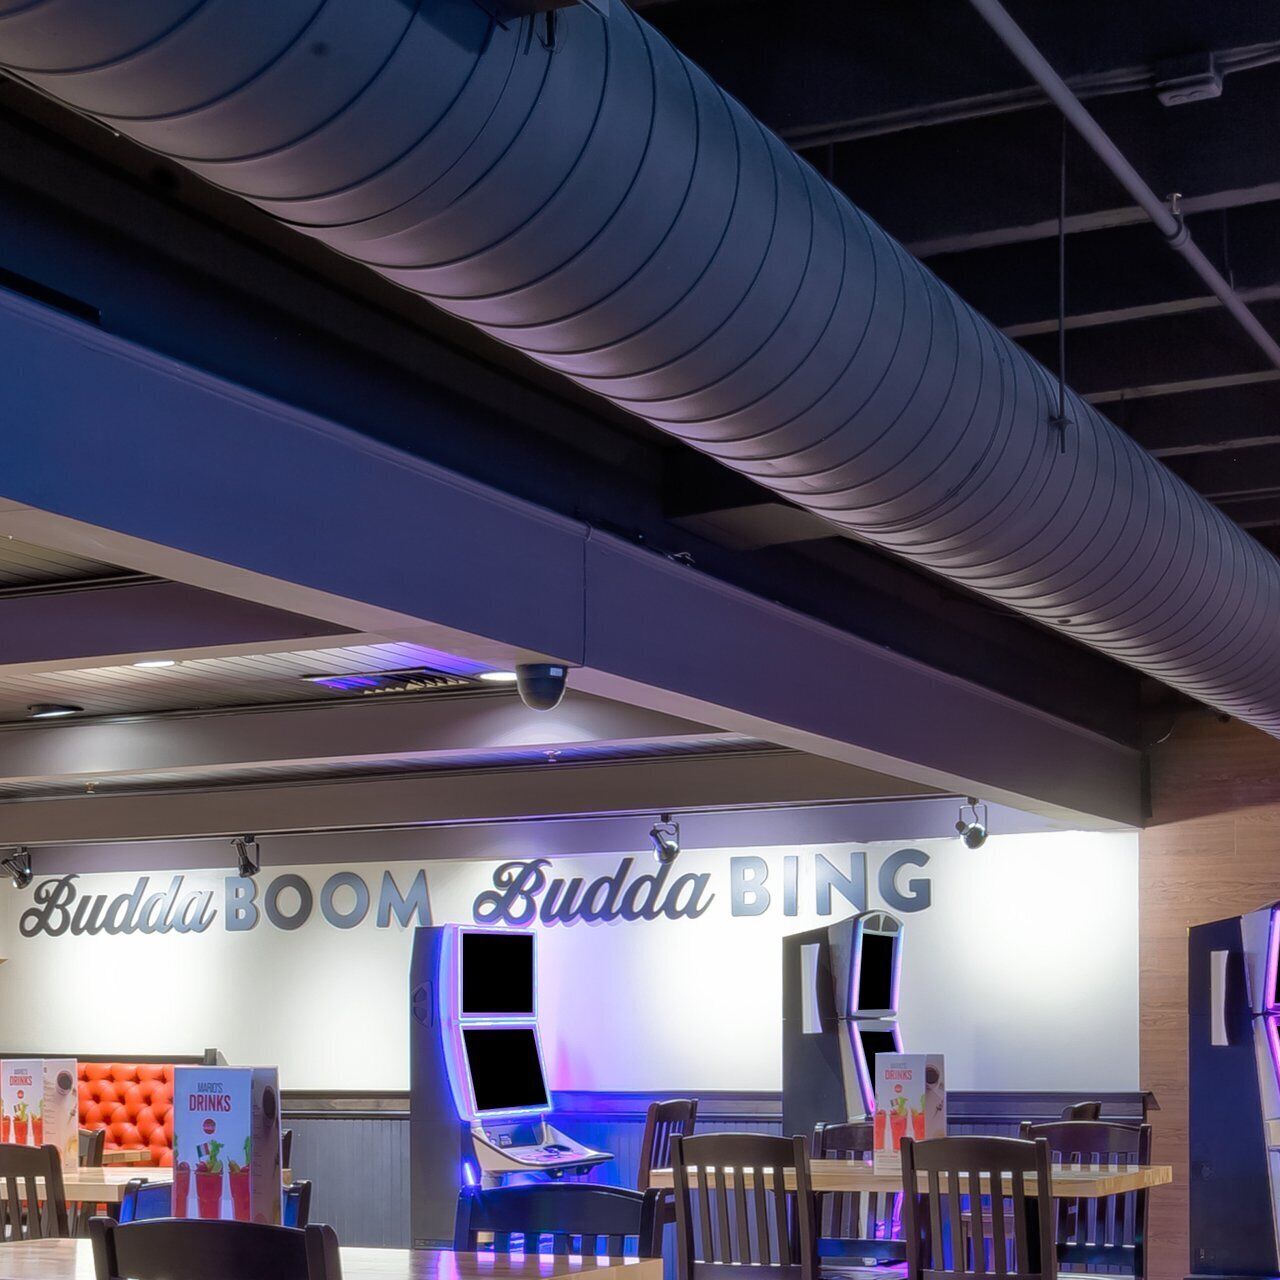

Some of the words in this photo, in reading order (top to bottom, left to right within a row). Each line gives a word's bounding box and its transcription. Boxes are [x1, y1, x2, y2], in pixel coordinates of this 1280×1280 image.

[473, 858, 716, 927] Budda
[730, 848, 931, 917] BING
[19, 874, 218, 937] Budda
[225, 869, 433, 931] BOOM
[9, 1075, 32, 1086] DRINKS
[884, 1069, 913, 1080] DRINKS
[197, 1082, 223, 1094] MARIO'S
[189, 1094, 231, 1112] DRINKS
